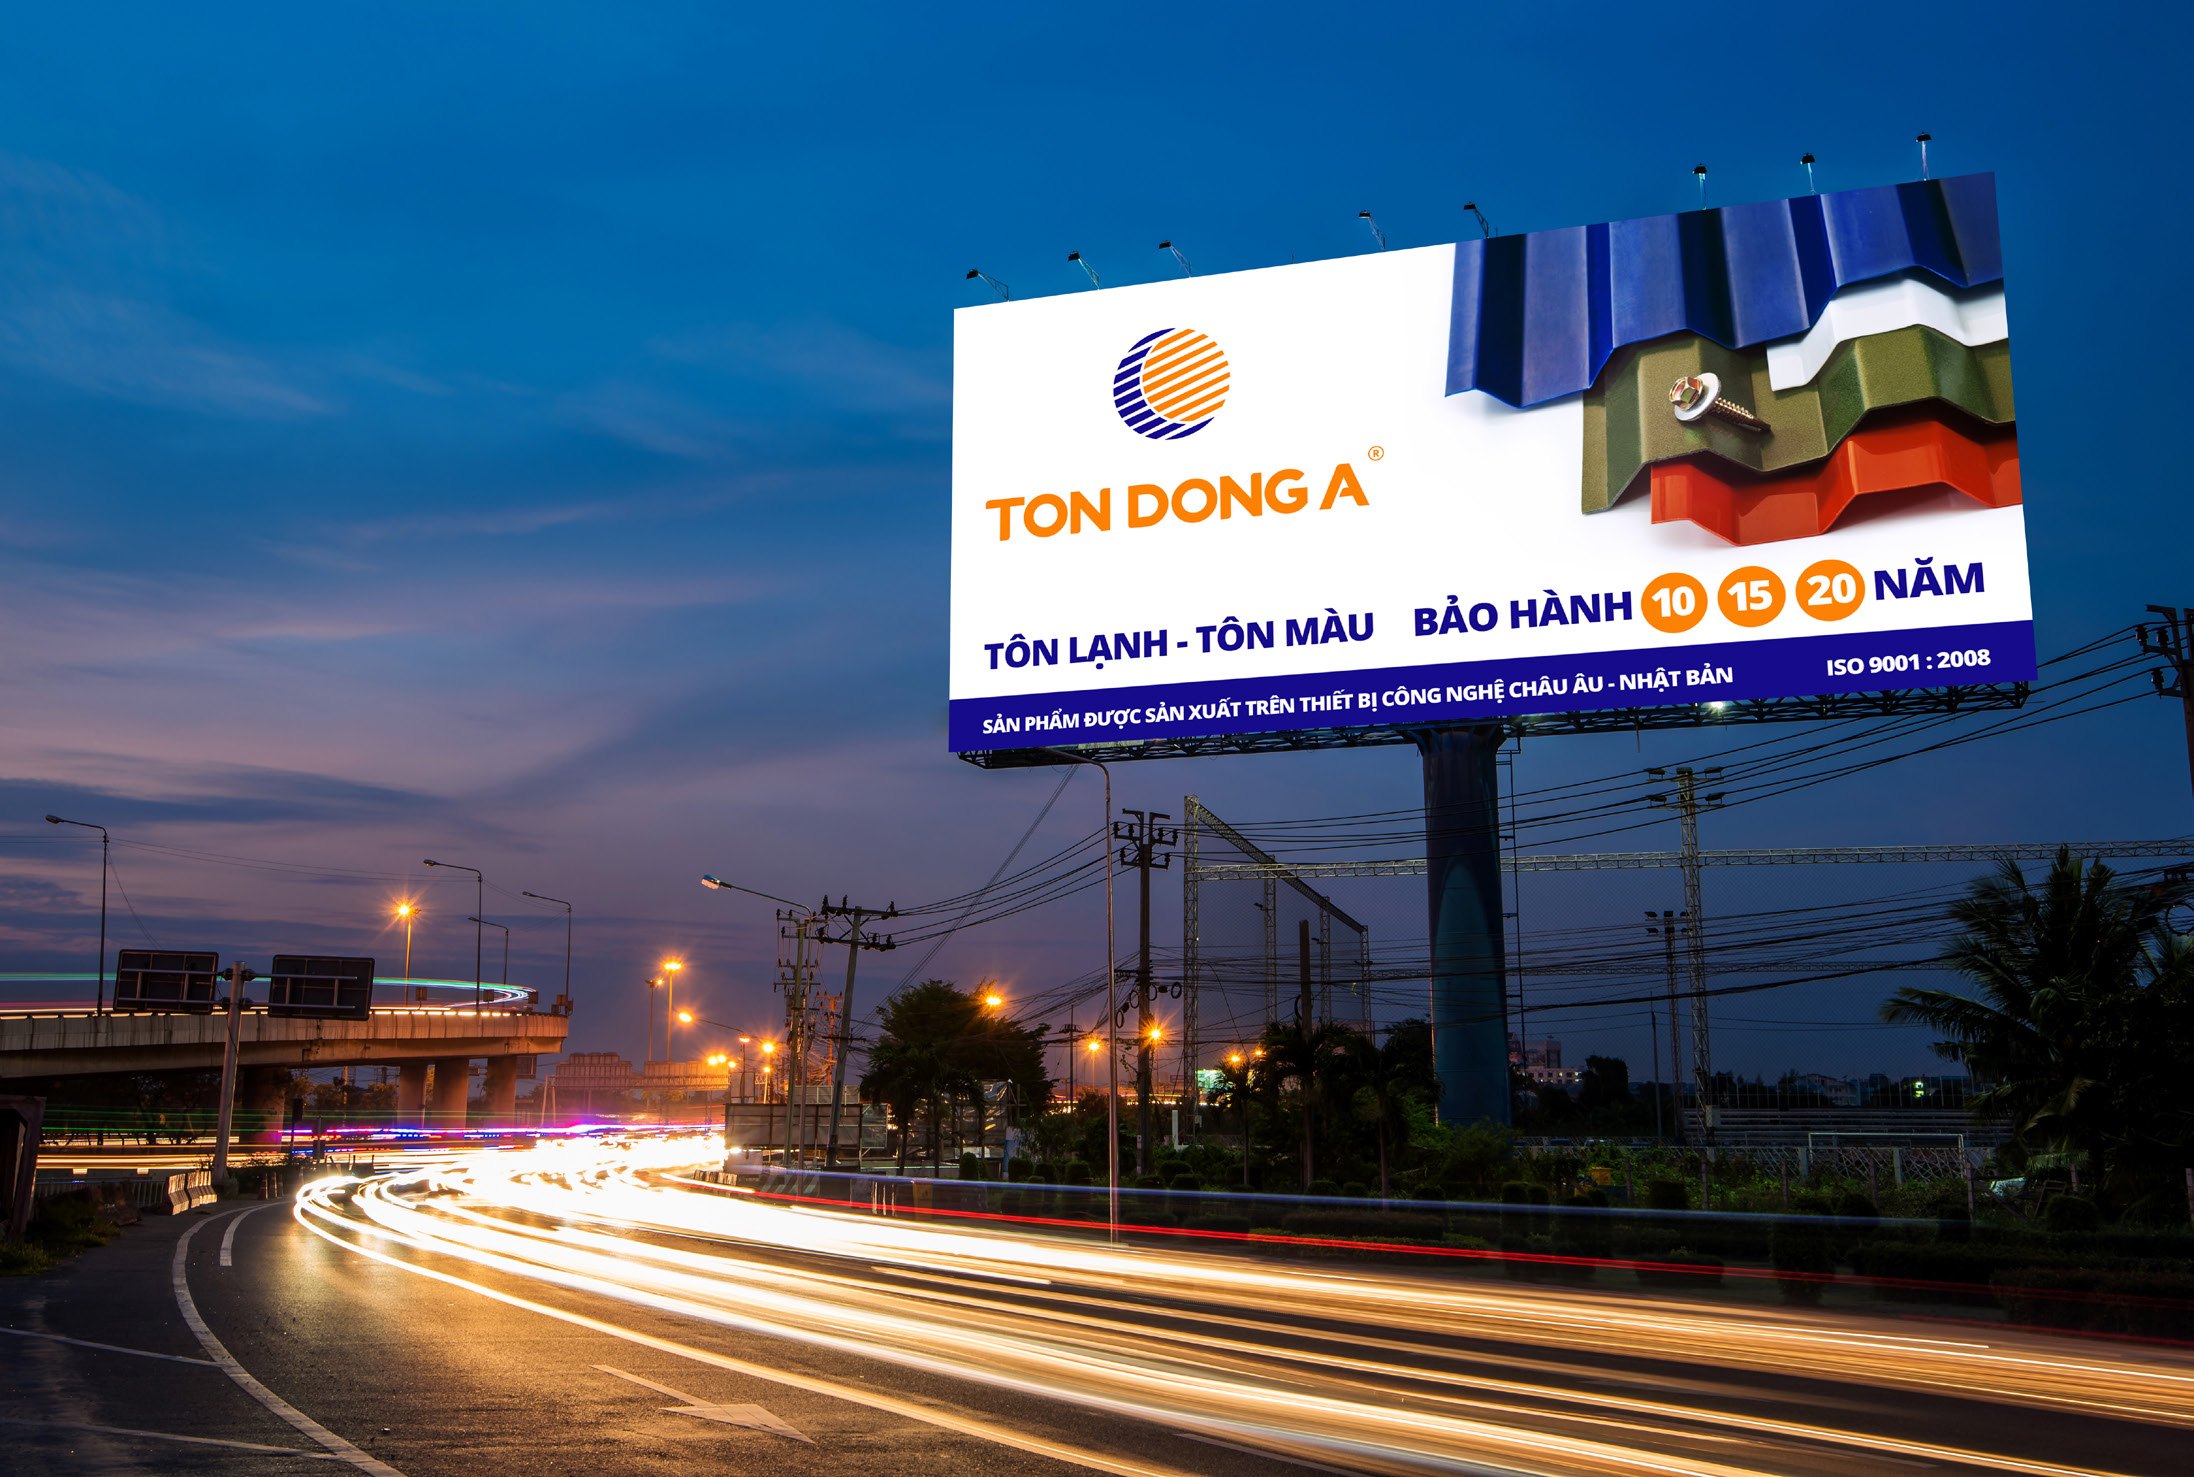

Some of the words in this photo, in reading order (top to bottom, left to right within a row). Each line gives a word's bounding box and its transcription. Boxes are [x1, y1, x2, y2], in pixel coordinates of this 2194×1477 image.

[986, 488, 1110, 541] TON
[1128, 469, 1308, 528] DONG
[1320, 464, 1369, 510] A
[1415, 595, 1498, 636] BẢO
[1511, 590, 1632, 629] HÀNH
[1652, 585, 1696, 618] 10
[1727, 580, 1773, 612] 15
[1806, 573, 1858, 606] 20
[1874, 557, 1984, 600] NĂM
[985, 634, 1058, 669] TÔN
[1070, 630, 1167, 669] LẠNH
[1196, 616, 1274, 653] TÔN
[1286, 608, 1373, 646] MÀU
[1827, 658, 1864, 676] ISO
[1869, 653, 1919, 674] 9001
[1927, 656, 1932, 670] :
[1937, 649, 1991, 669] 2008
[982, 713, 1020, 734] SẢN
[1026, 708, 1079, 731] PHẨM
[1084, 709, 1141, 730] ĐƯỢC
[1146, 702, 1184, 723] SẢN
[1189, 697, 1241, 720] XUẤT
[1245, 695, 1294, 717] TRÊN
[1300, 689, 1353, 712] THIẾT
[1359, 692, 1377, 712] BỊ
[1382, 685, 1441, 707] CÔNG
[1447, 679, 1504, 704] NGHỆ
[1509, 676, 1567, 698] CHÂU
[1573, 673, 1603, 693] ÂU
[1620, 667, 1680, 694] NHẬT
[1686, 662, 1732, 685] BẢN
